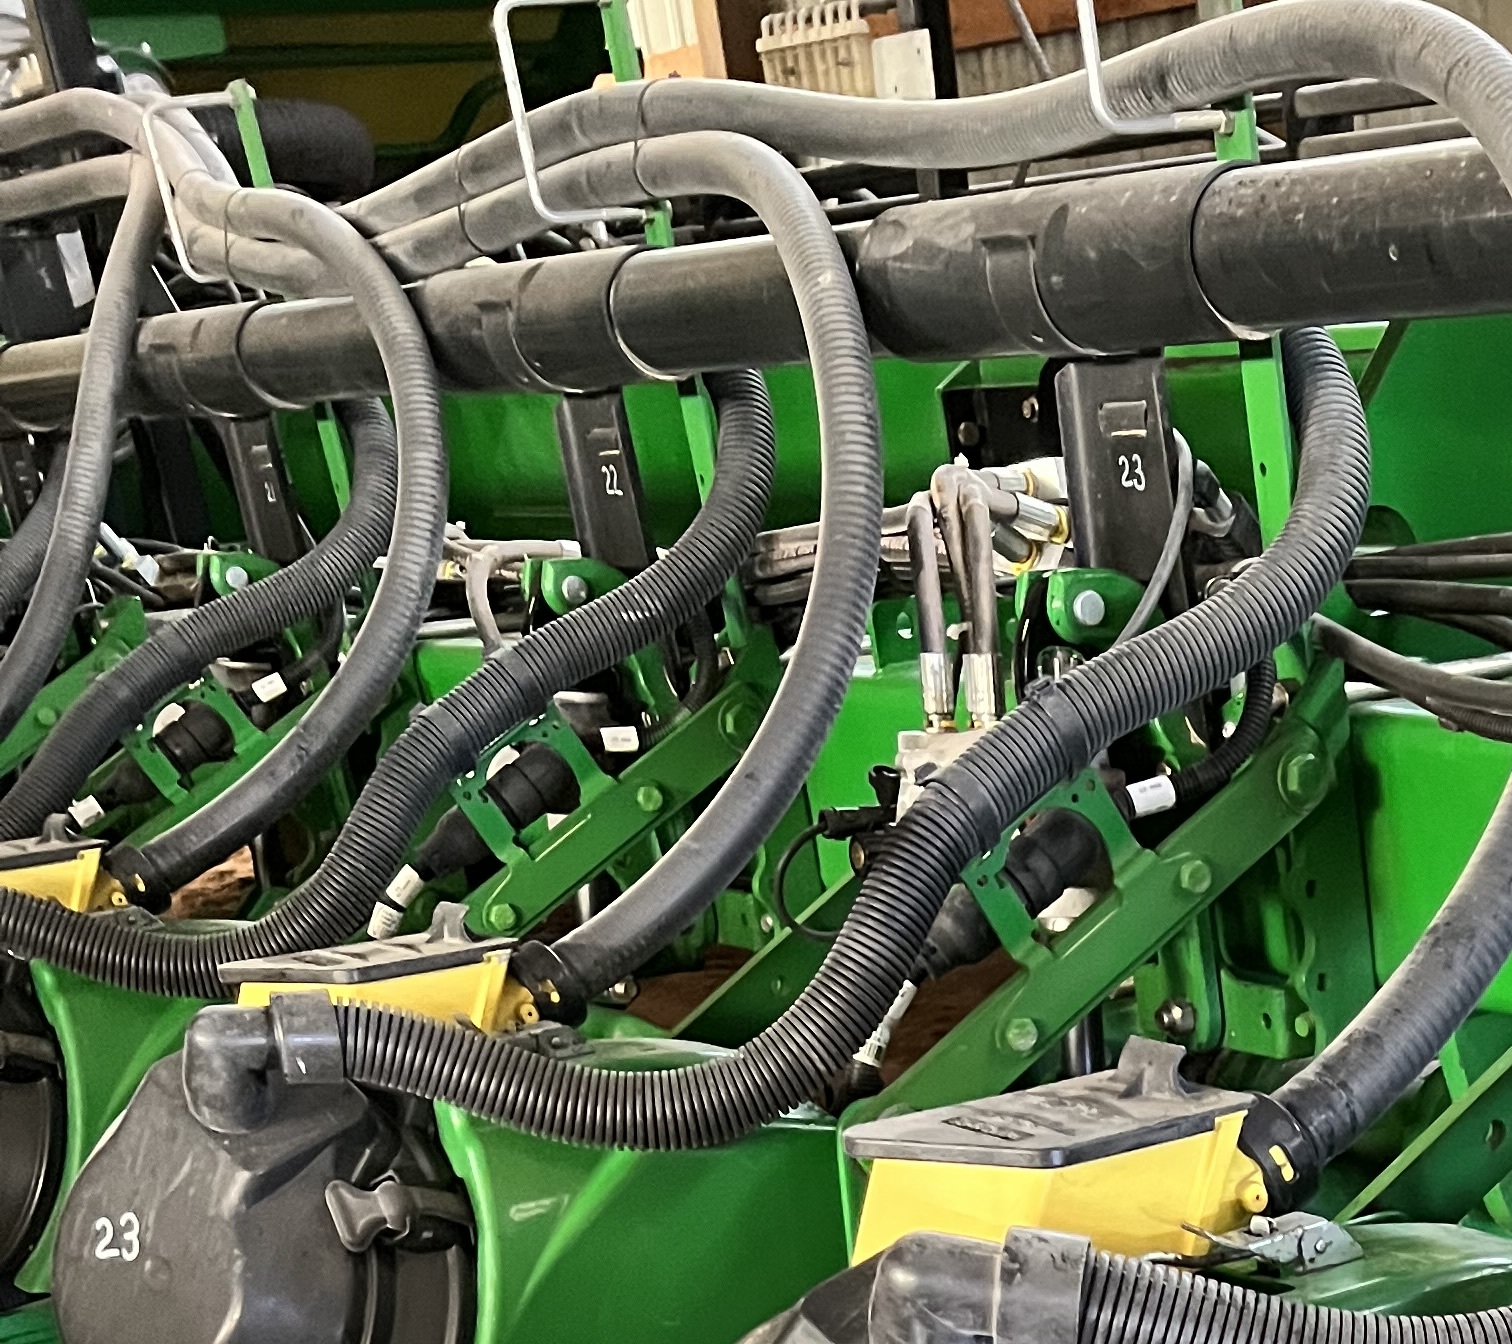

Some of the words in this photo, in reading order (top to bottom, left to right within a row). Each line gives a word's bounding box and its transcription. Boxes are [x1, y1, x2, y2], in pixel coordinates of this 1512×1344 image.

[601, 464, 624, 496] 22
[1118, 453, 1146, 491] 23
[95, 1211, 140, 1262] 23
